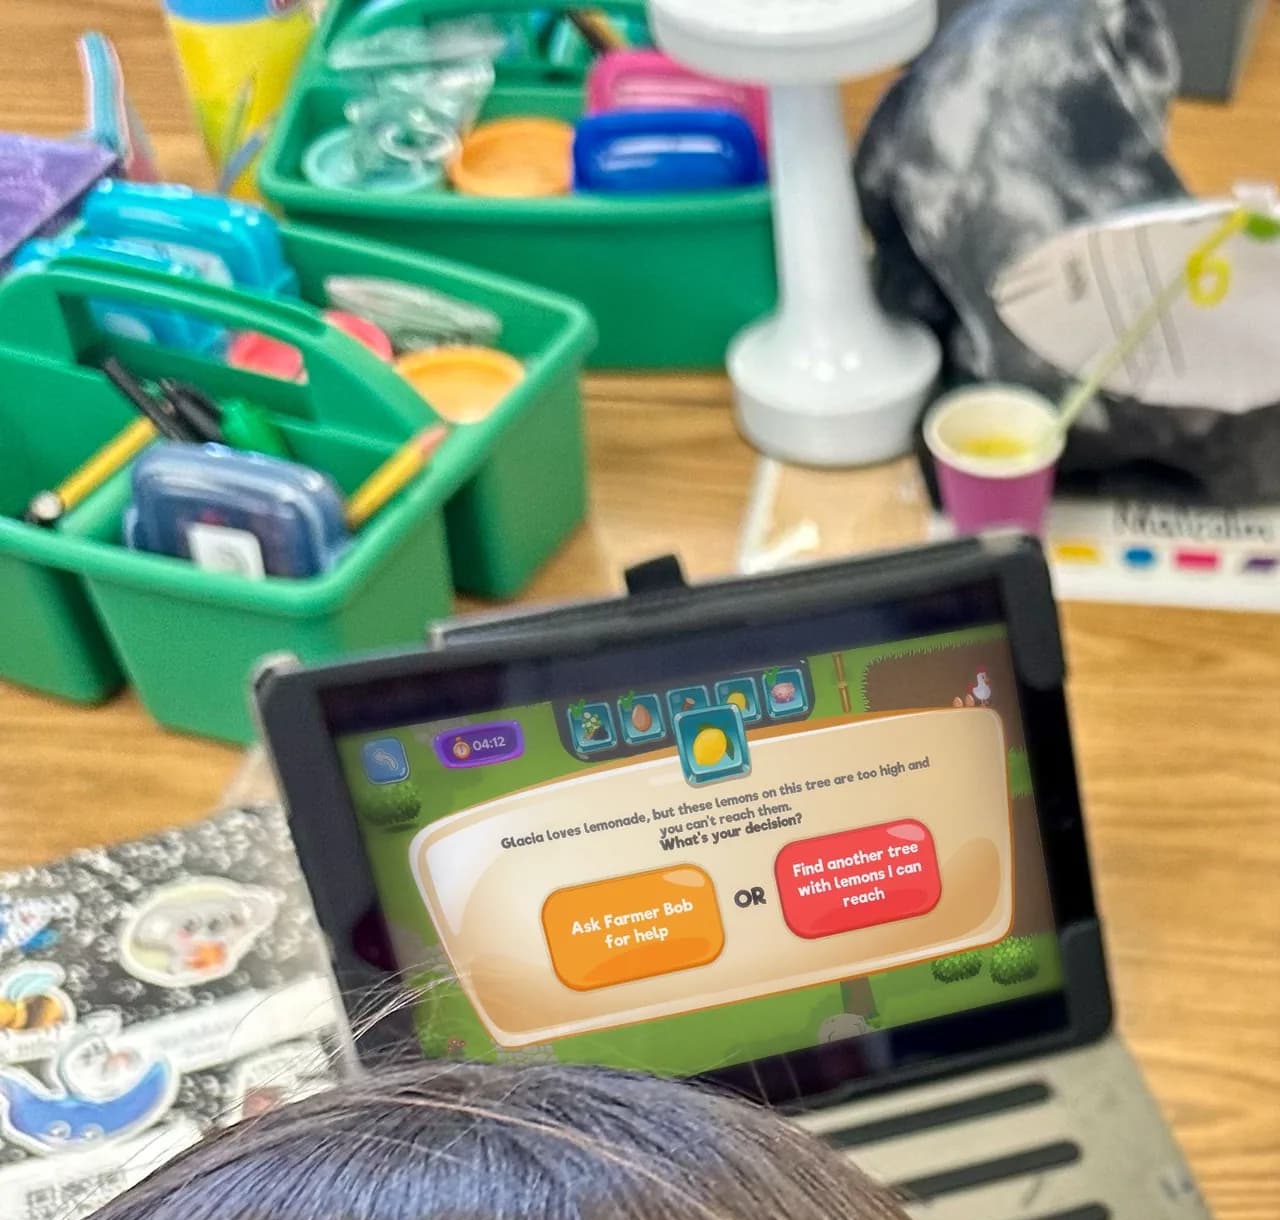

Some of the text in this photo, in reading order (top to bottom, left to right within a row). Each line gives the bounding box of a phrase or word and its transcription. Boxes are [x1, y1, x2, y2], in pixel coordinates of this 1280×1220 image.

[473, 736, 506, 751] 04:12
[501, 756, 930, 849] Glacia loves lemonade, but these lemons on this tree are too high and
[659, 802, 792, 839] you can't reach them.
[659, 813, 803, 850] What's your decision?
[792, 842, 919, 878] Find another tree
[734, 886, 767, 908] OR
[797, 861, 922, 897] with lemons I can
[842, 887, 885, 908] reach
[571, 899, 694, 935] Ask Farmer Bob
[604, 926, 669, 949] for help
